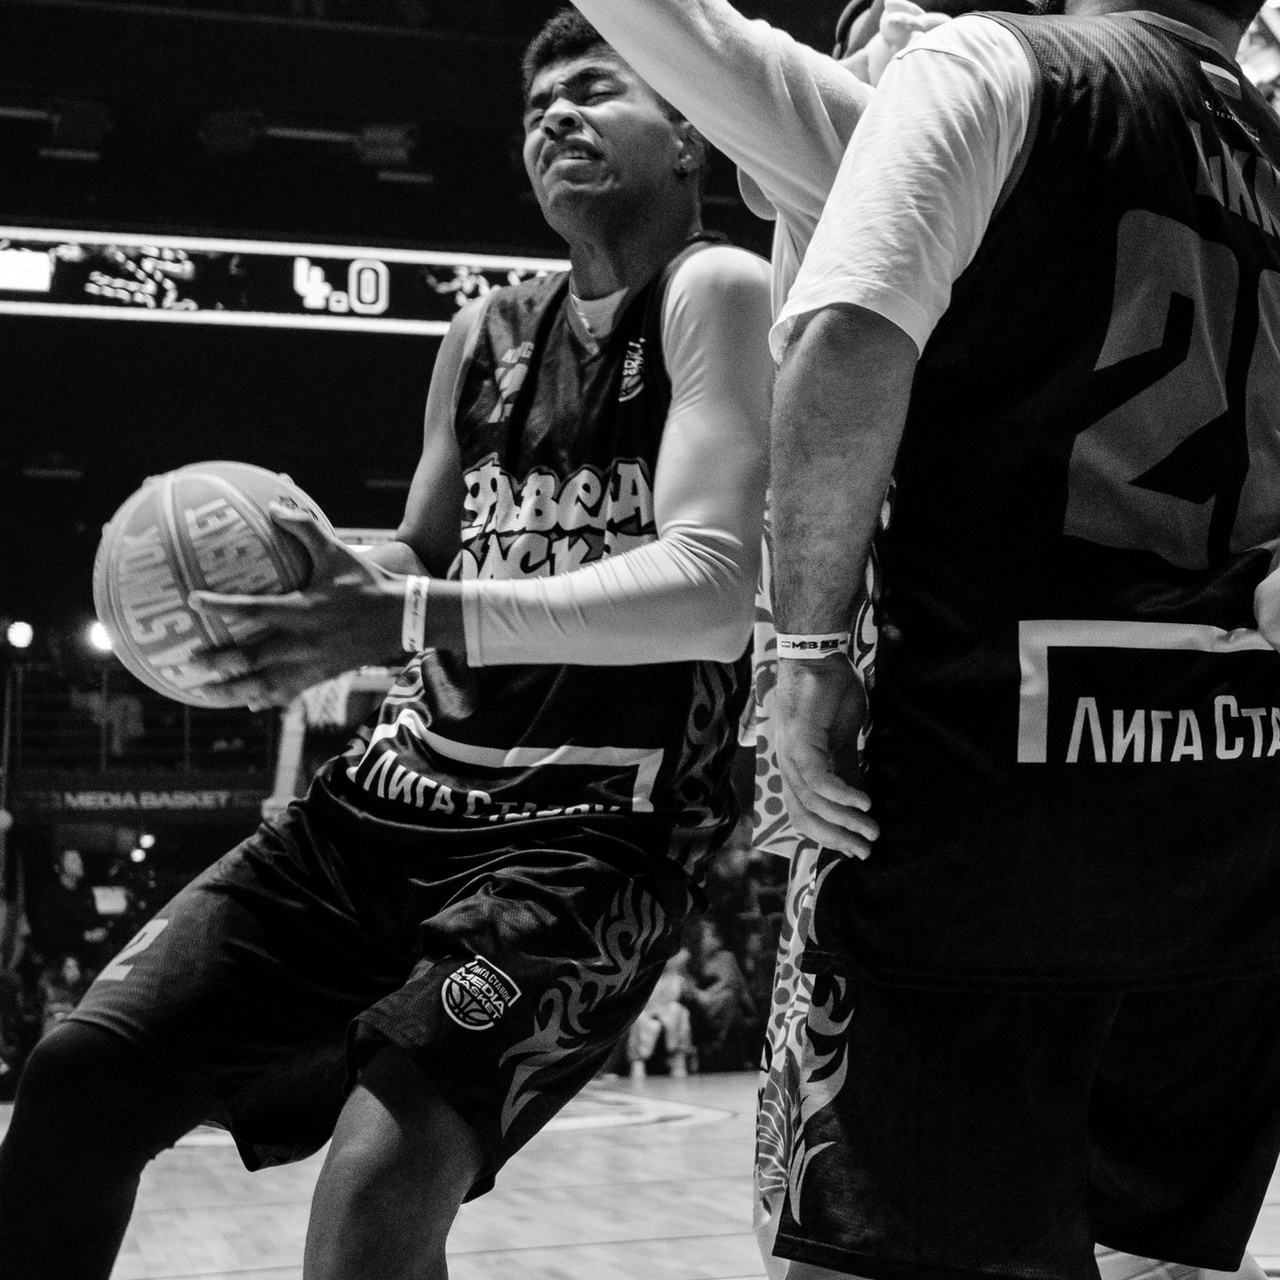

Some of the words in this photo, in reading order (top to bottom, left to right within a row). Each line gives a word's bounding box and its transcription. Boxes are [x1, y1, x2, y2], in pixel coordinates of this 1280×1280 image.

[1065, 696, 1203, 763] ЛИГА
[363, 749, 455, 815] ЛИГА
[449, 972, 501, 1019] BASKET
[456, 966, 504, 1015] MEDIA
